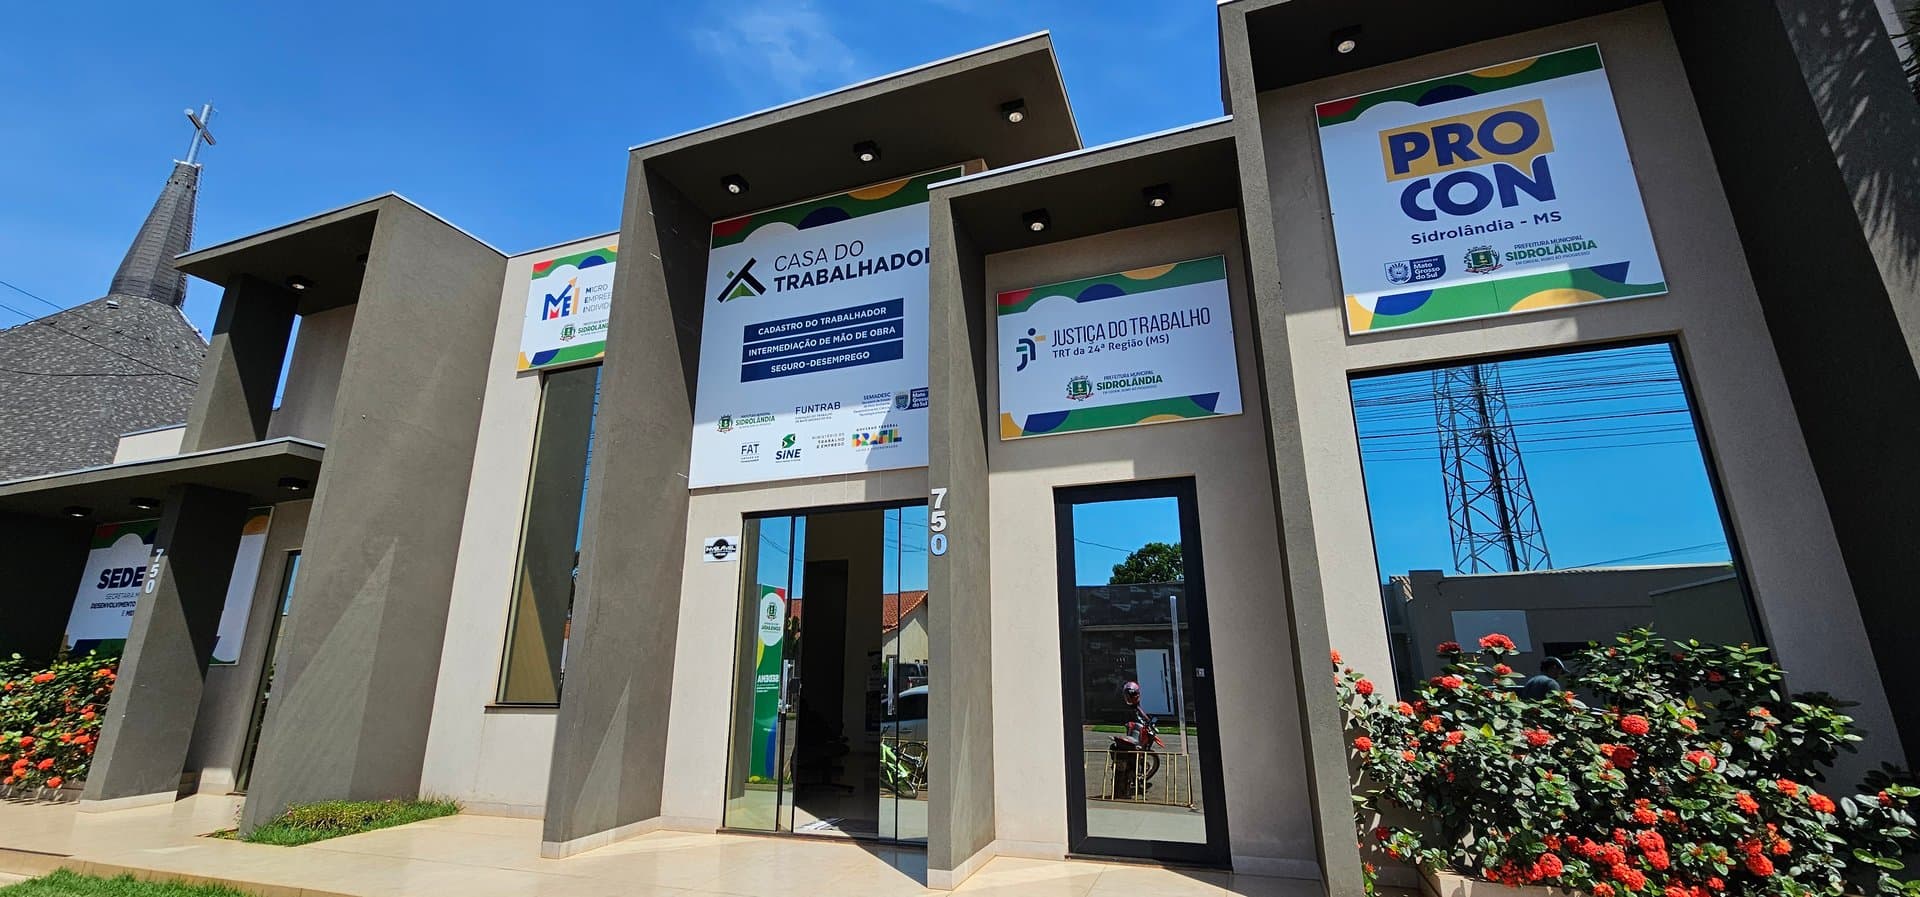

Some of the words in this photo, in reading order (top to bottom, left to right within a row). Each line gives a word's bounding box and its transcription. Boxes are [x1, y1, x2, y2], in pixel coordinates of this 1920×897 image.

[1388, 110, 1540, 175] PRO
[1400, 155, 1557, 222] CON
[1411, 218, 1515, 245] Sidrolândia
[1535, 211, 1562, 226] MS
[774, 248, 828, 272] CASA
[834, 240, 864, 260] DO
[1415, 267, 1441, 275] Grosso
[585, 283, 609, 295] MICRO
[758, 322, 803, 336] CADASTRO
[805, 319, 818, 328] DO
[820, 307, 887, 326] TRABALHADOR
[1052, 323, 1105, 347] JUSTIÇA
[1108, 319, 1127, 339] DO
[1129, 307, 1211, 335] TRABALHO
[748, 338, 817, 357] INTERMEDIAÇÃO
[819, 336, 831, 346] DE
[832, 332, 853, 344] MÃO
[855, 331, 868, 340] DE
[869, 326, 896, 338] OBRA
[1053, 349, 1071, 359] TRT
[1073, 347, 1085, 356] da
[1087, 343, 1105, 354] 24ª
[1108, 338, 1143, 352] Região
[1146, 334, 1170, 347] (MS)
[770, 351, 870, 373] SEGURO-DESEMPREGO
[795, 401, 841, 415] FUNTRAB
[741, 443, 760, 455] FAT
[851, 427, 903, 448] BRASIL
[931, 488, 948, 556] 750
[145, 549, 164, 594] 750
